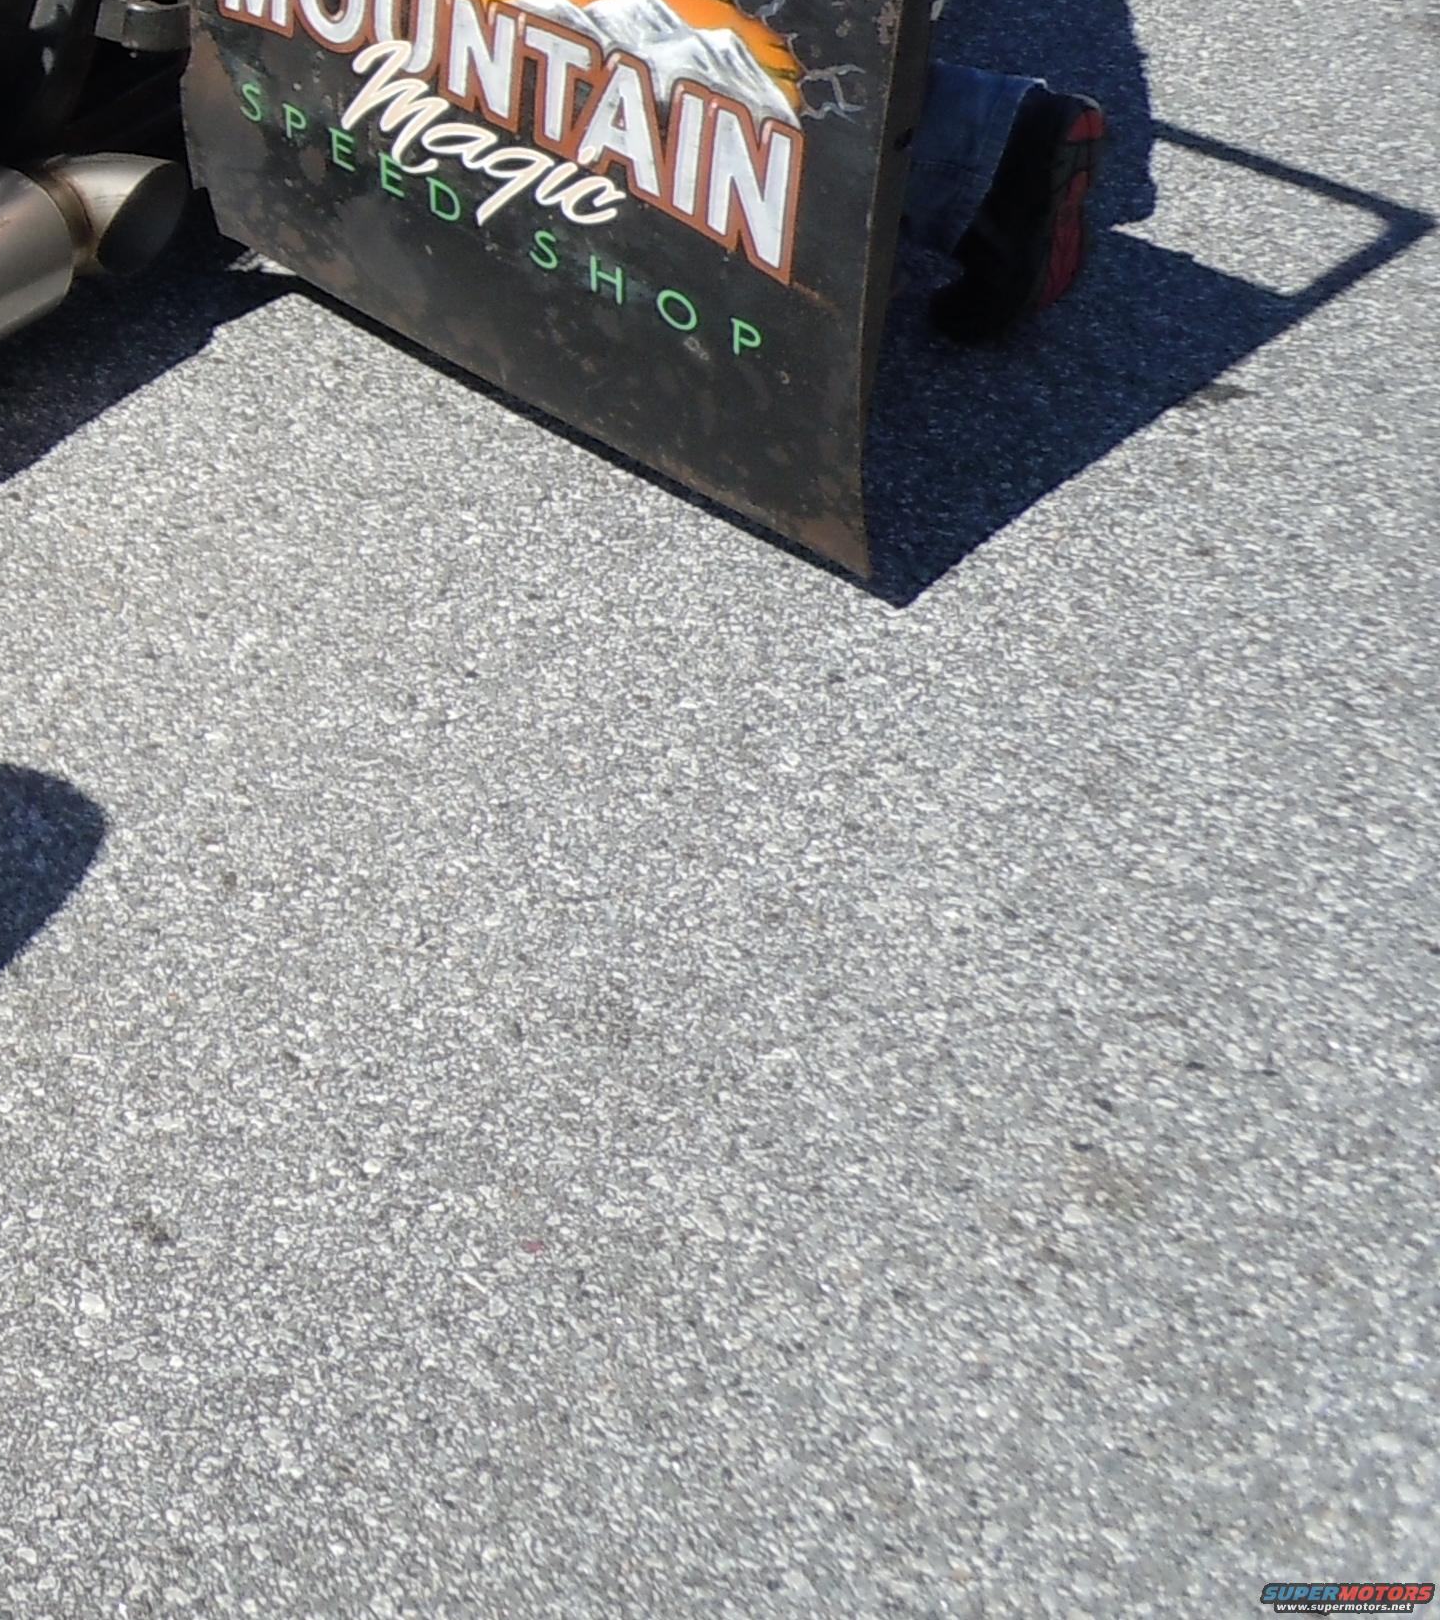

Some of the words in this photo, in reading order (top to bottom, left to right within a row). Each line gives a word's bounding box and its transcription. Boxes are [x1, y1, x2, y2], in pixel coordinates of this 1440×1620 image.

[240, 83, 463, 223] SPEED
[528, 230, 764, 357] SHOP
[341, 40, 627, 227] Magic
